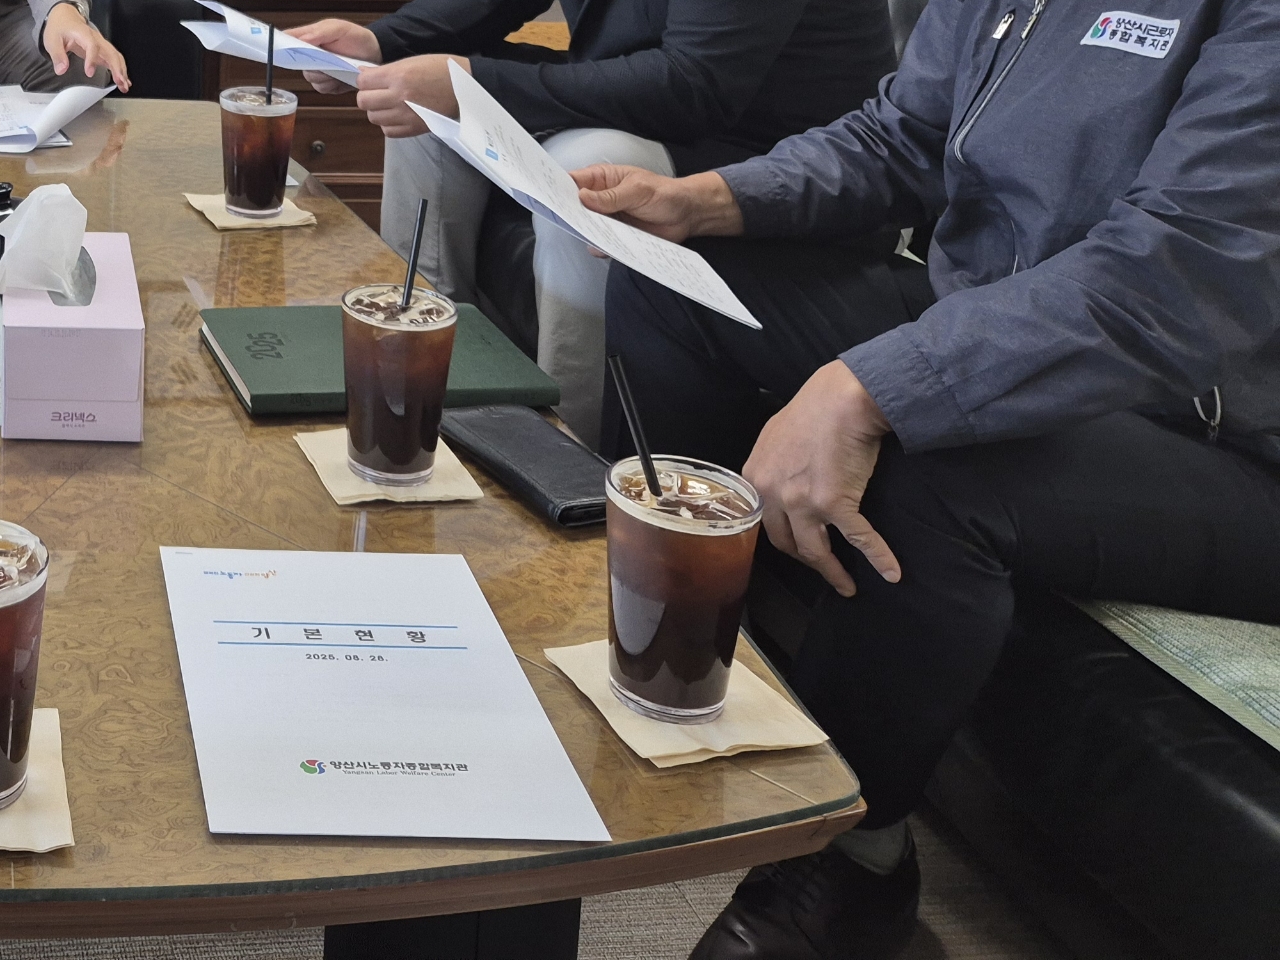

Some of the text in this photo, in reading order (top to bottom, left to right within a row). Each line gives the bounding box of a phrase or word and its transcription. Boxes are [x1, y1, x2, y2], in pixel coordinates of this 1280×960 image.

[1116, 18, 1174, 38] 양산시근로자
[245, 332, 285, 360] 2025
[50, 411, 97, 423] 크리넥스
[251, 627, 426, 643] 기 본 현 황
[305, 653, 339, 661] 2025.
